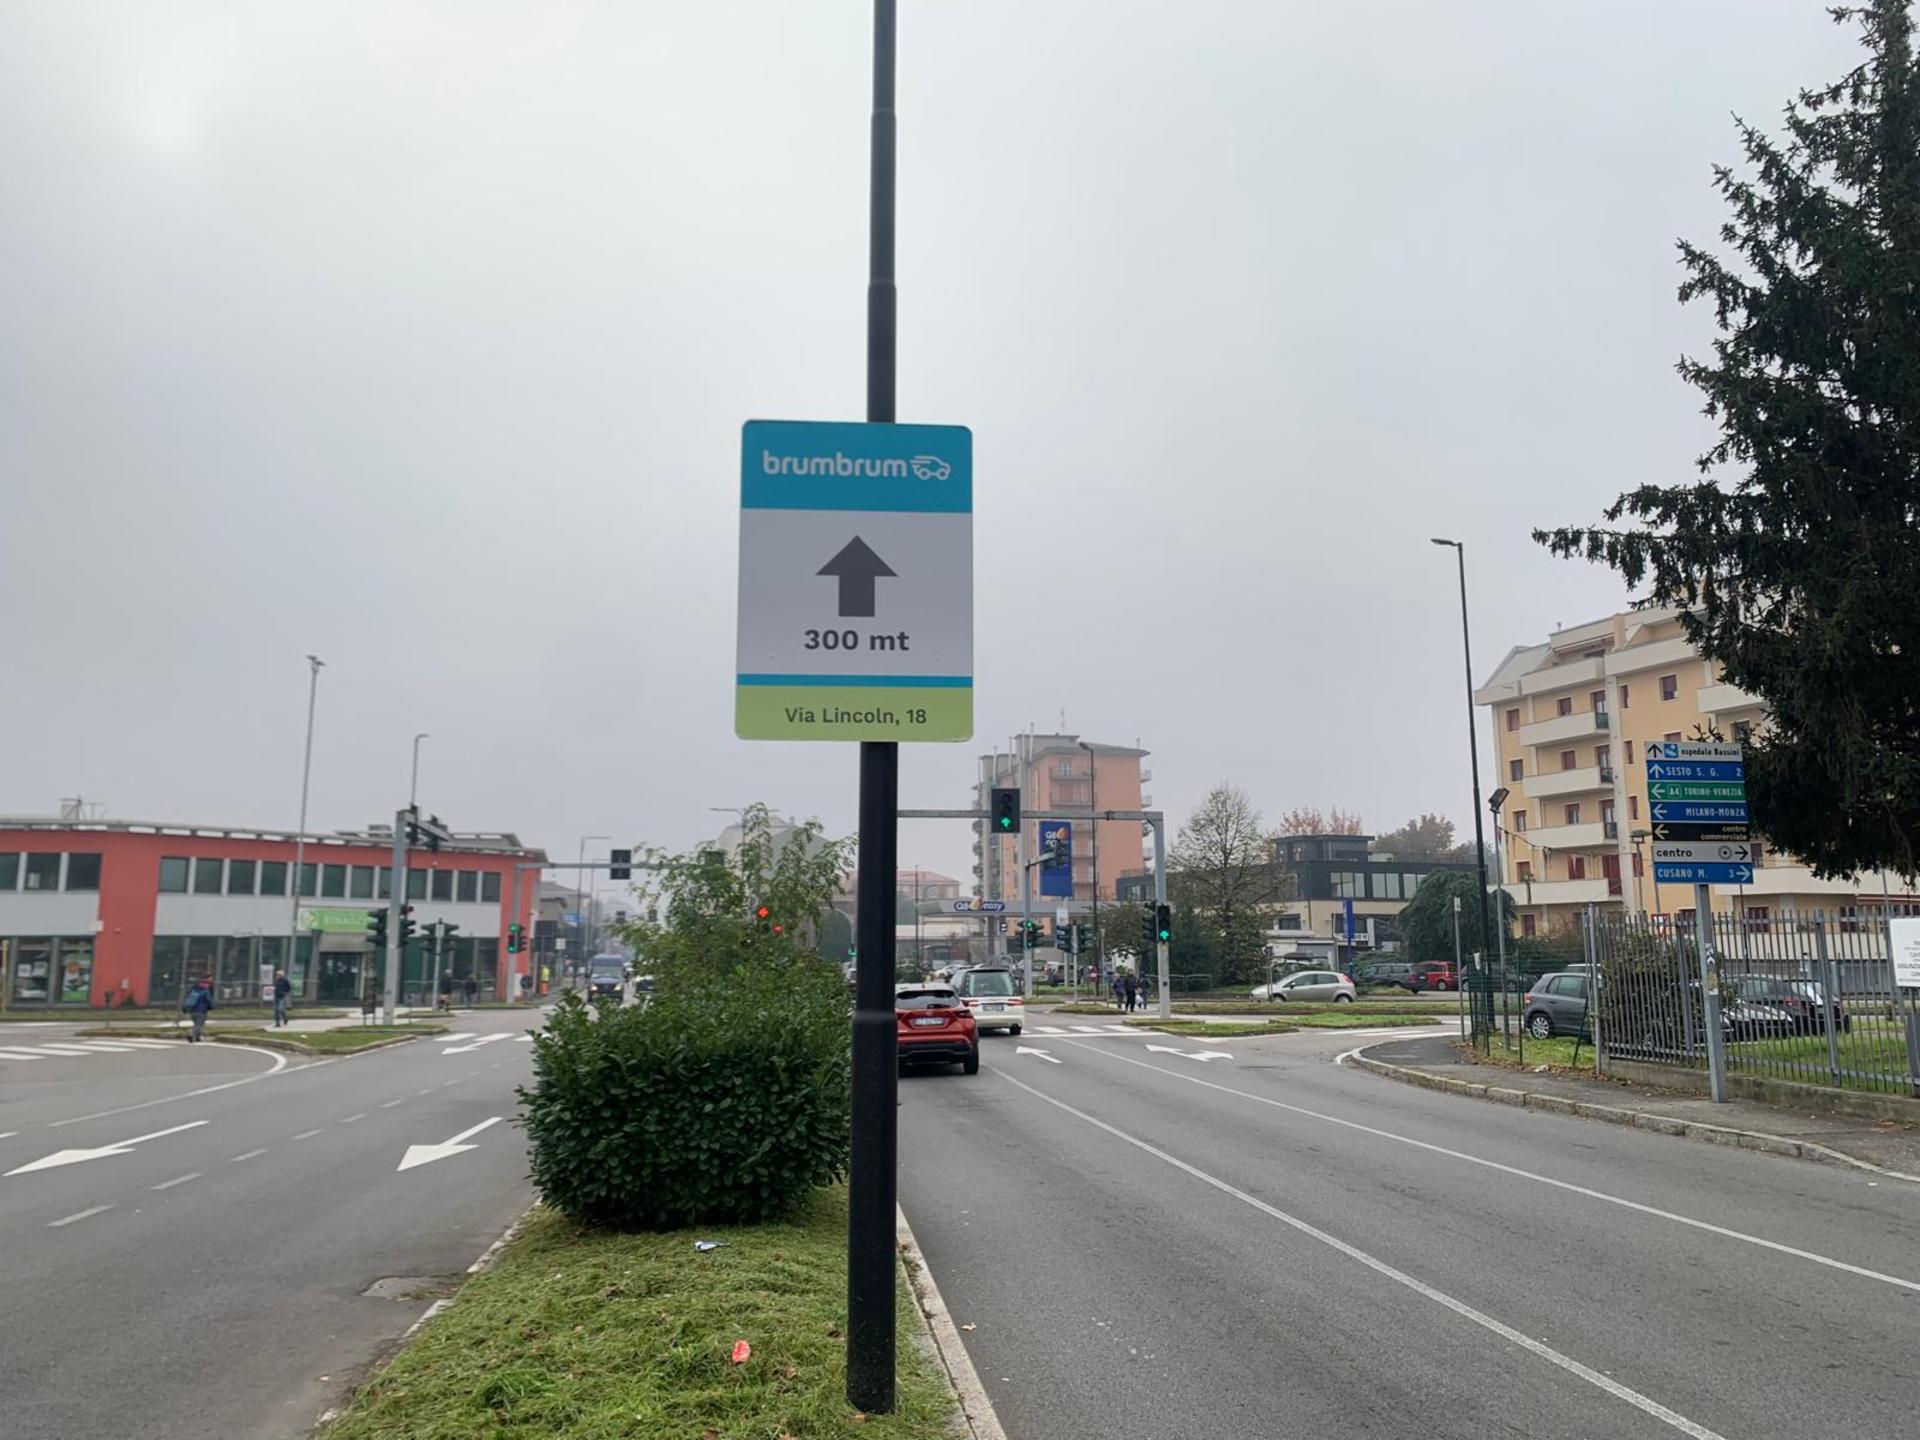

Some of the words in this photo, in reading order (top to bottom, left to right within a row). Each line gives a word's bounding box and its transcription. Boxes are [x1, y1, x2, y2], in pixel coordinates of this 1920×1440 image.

[763, 449, 908, 478] brumbrum
[803, 629, 859, 650] 300
[869, 631, 910, 651] mt
[784, 706, 816, 723] Via
[822, 707, 900, 726] Lincoln,
[906, 708, 927, 724] 18
[1681, 747, 1712, 757] ospedale
[1714, 748, 1740, 756] Bassini
[1665, 766, 1692, 777] SESTO
[1735, 768, 1742, 777] 2
[1669, 787, 1680, 796] A4
[1685, 807, 1746, 817] MILANO-MONZA
[1700, 833, 1747, 841] commerciale
[1656, 848, 1693, 857] centro
[1657, 868, 1693, 879] CUSANO
[1728, 869, 1735, 879] 3
